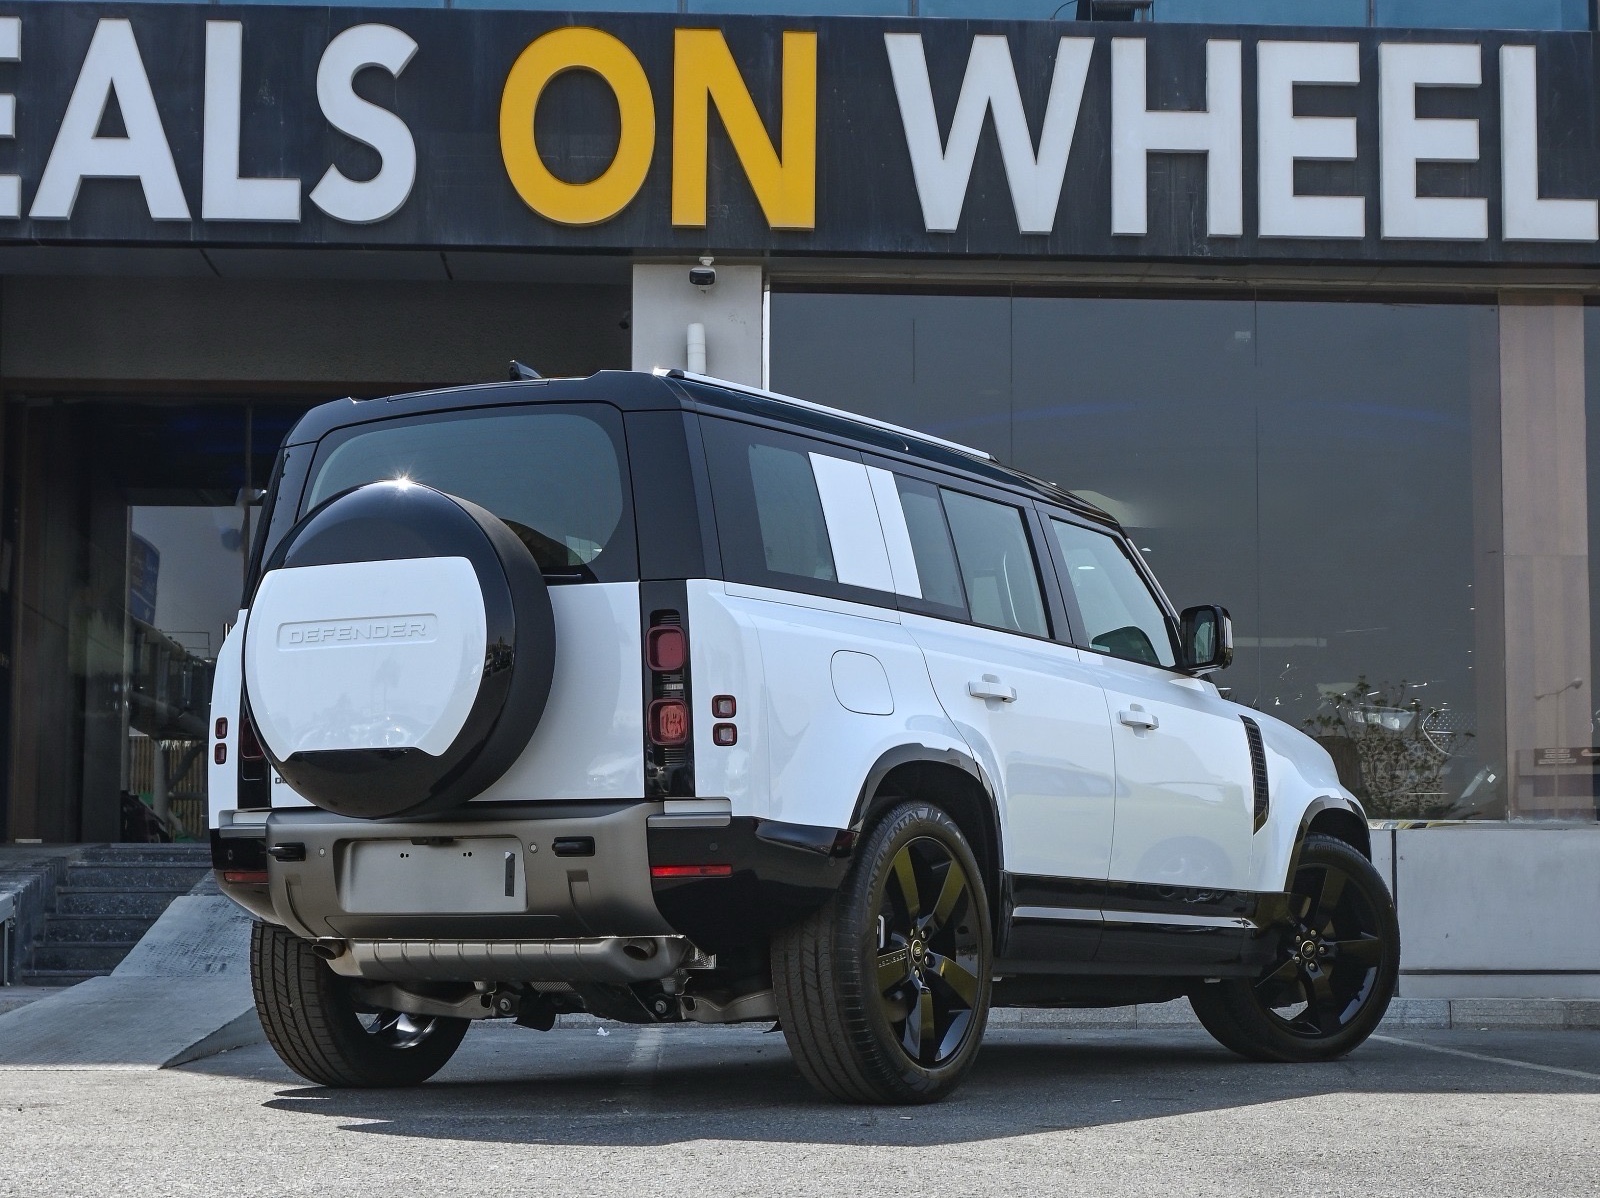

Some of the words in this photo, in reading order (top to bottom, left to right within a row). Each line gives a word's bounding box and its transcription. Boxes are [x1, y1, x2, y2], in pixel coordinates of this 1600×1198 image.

[0, 17, 418, 225] ALS
[499, 27, 818, 230] ON
[884, 32, 1599, 243] WHEEL
[289, 621, 427, 645] DEFENDER
